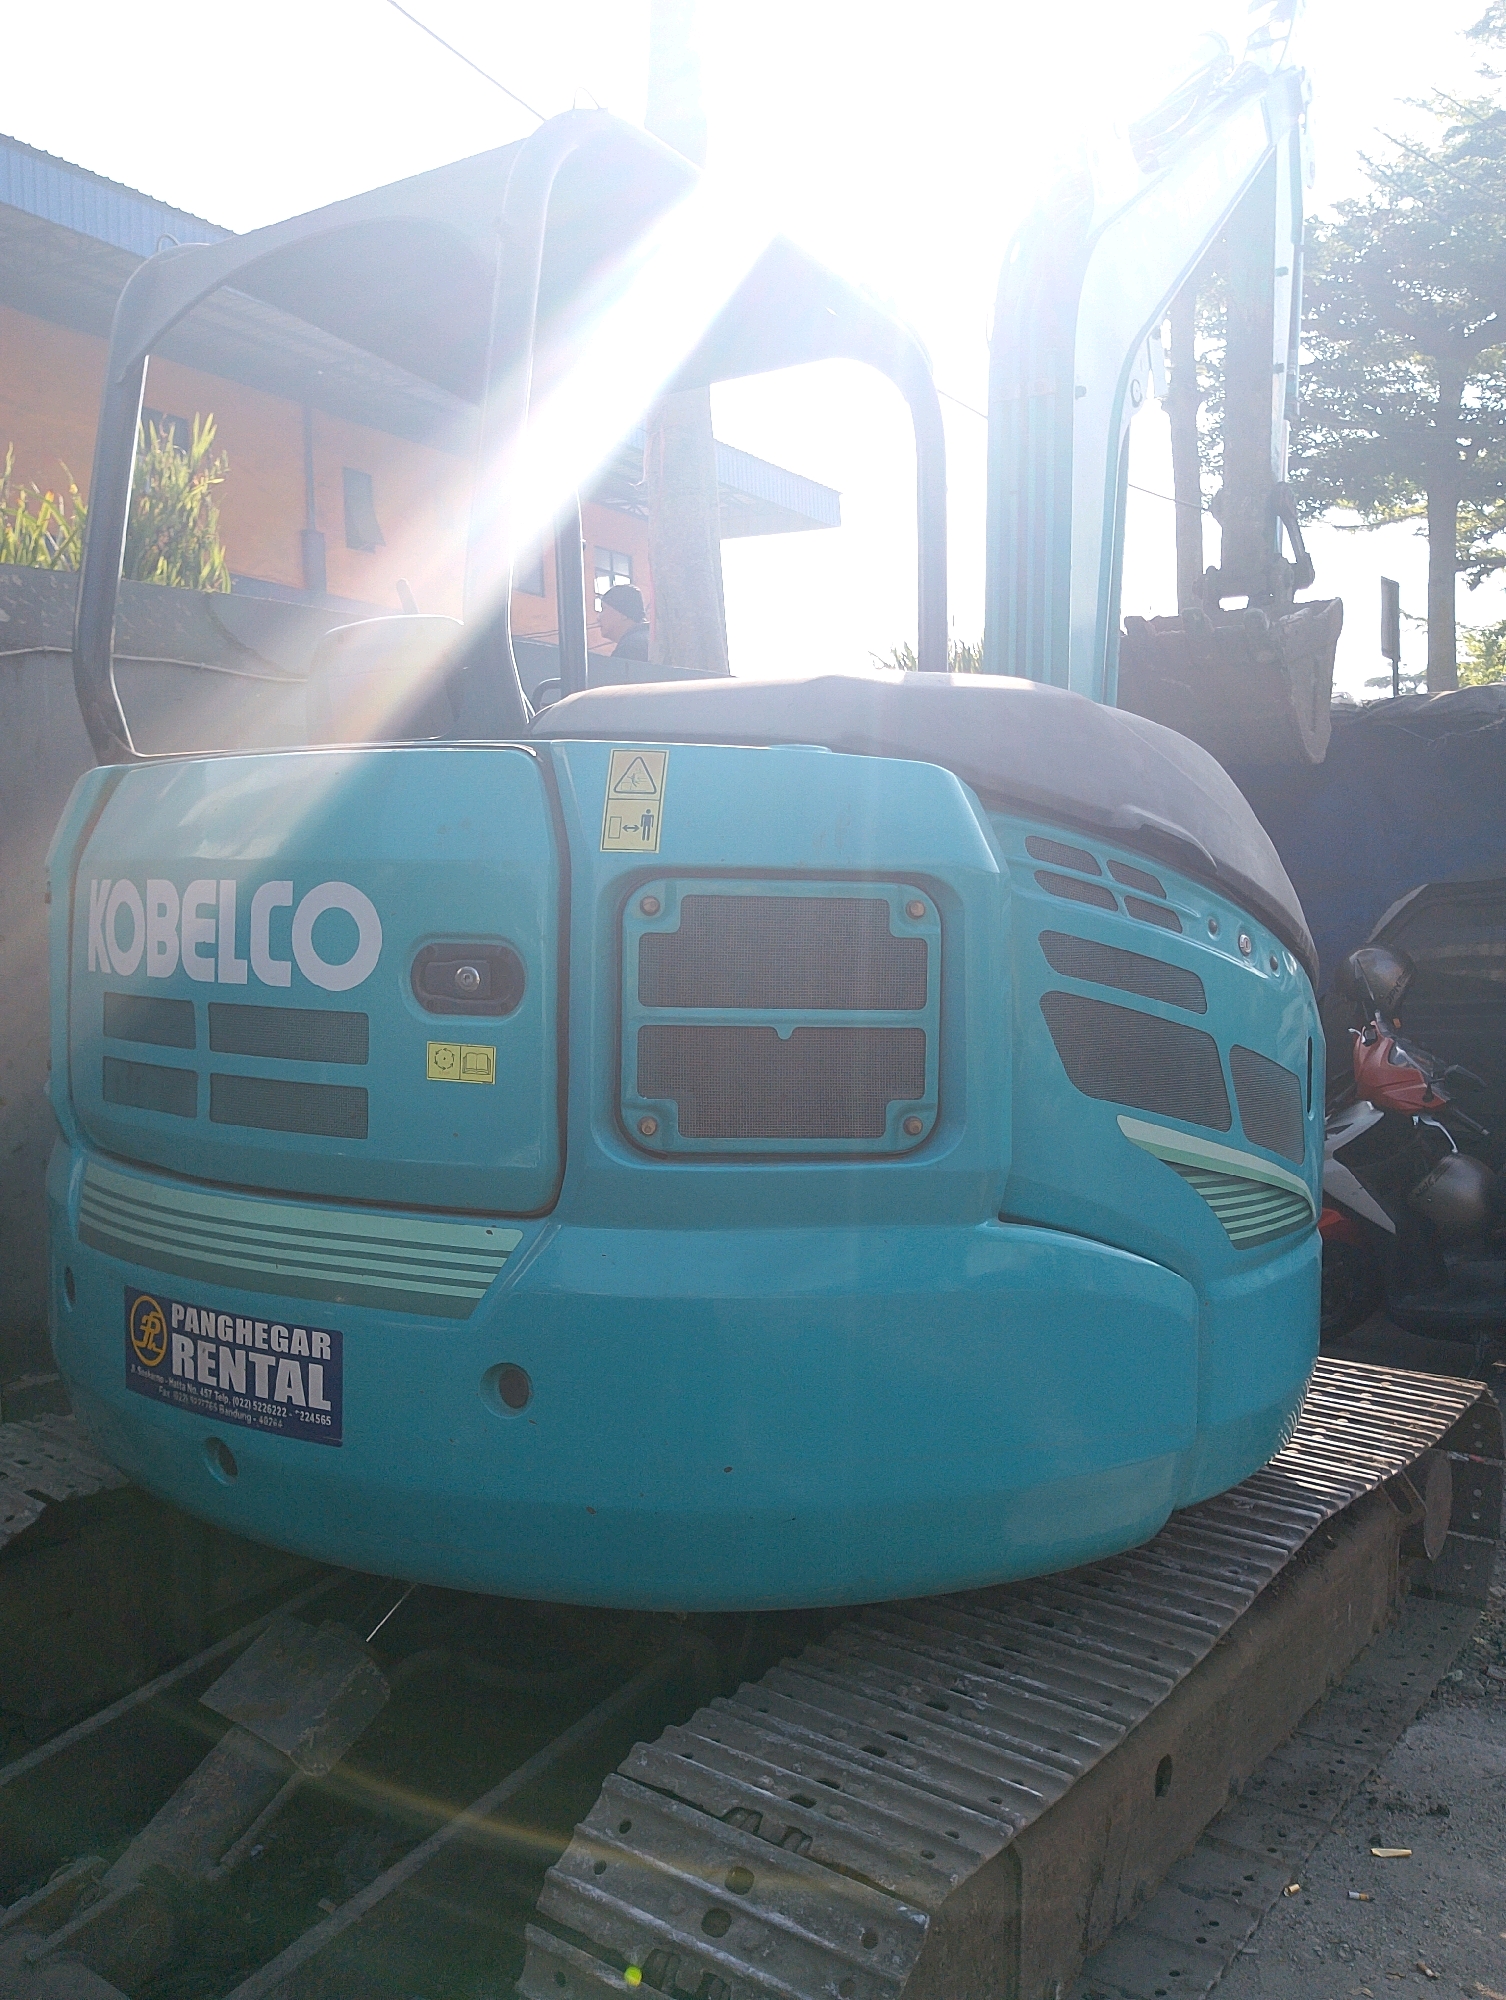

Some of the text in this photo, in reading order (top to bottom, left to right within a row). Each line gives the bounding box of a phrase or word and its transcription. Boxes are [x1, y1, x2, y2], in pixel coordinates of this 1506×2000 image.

[88, 879, 382, 991] KOBELCO
[171, 1302, 331, 1360] PANGHEGAR
[171, 1332, 331, 1411] RENTAL
[187, 1382, 199, 1396] No.
[232, 1396, 251, 1411] (022)
[253, 1401, 288, 1417] 5226222
[219, 1404, 252, 1424] Bandung
